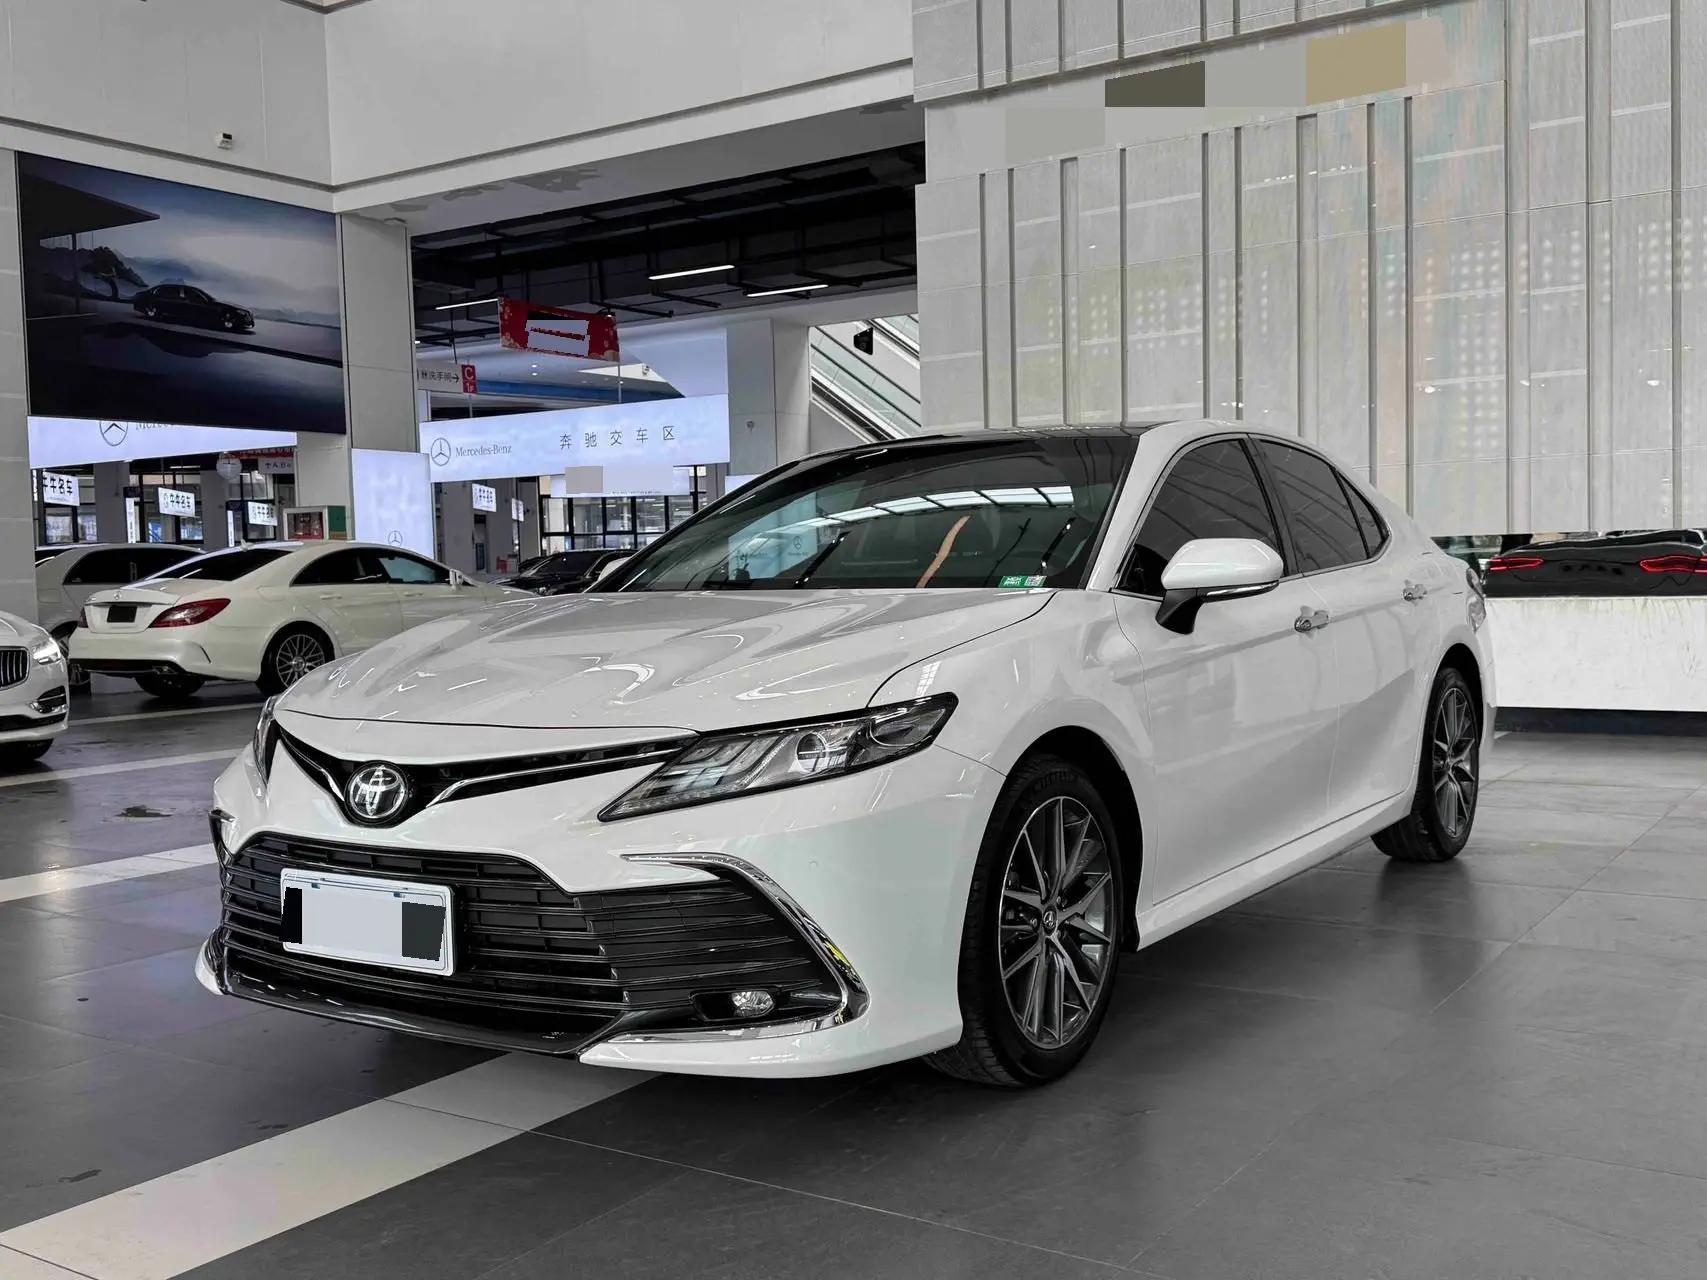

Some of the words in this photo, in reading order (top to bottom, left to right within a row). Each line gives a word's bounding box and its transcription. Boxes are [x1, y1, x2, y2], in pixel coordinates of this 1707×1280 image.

[464, 366, 475, 380] C
[559, 425, 675, 450] 奔驰交车区
[455, 444, 512, 458] Mercedes-Benz
